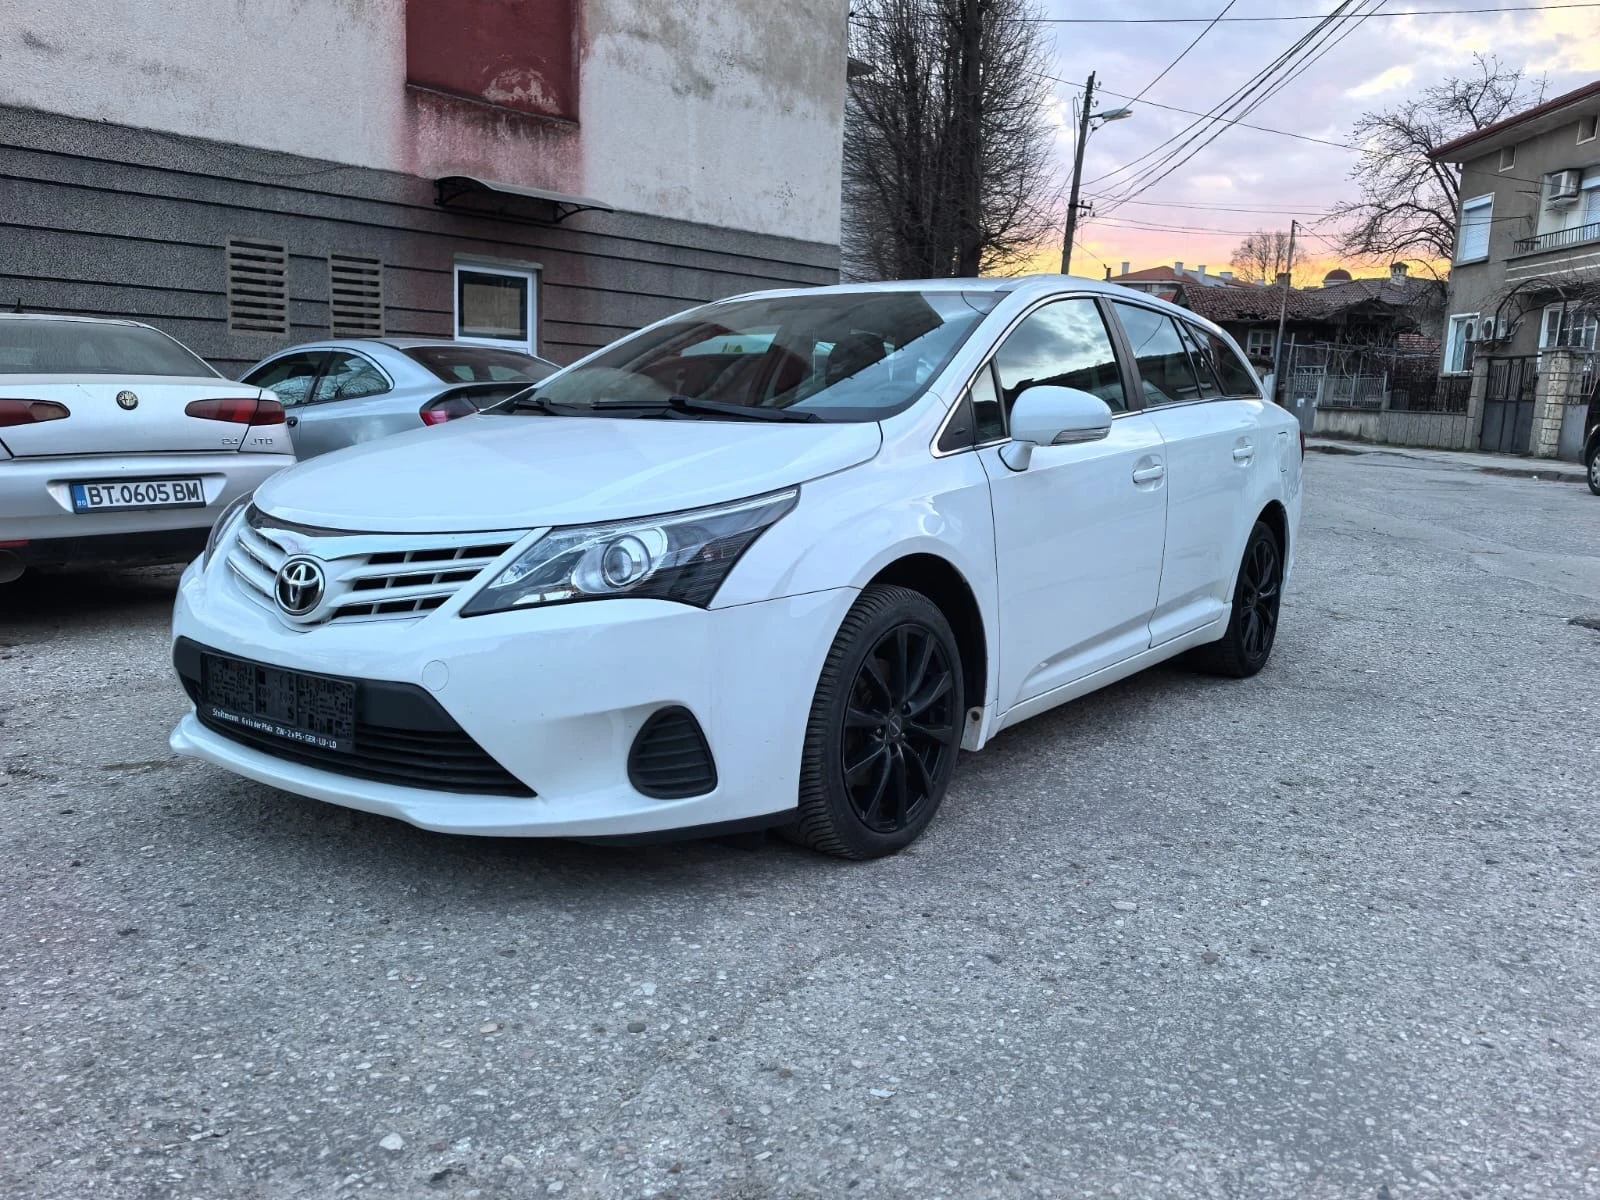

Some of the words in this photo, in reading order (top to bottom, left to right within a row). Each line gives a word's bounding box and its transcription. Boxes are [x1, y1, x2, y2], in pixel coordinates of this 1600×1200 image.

[87, 485, 115, 506] BT
[120, 483, 170, 503] 0605
[172, 482, 200, 501] BM
